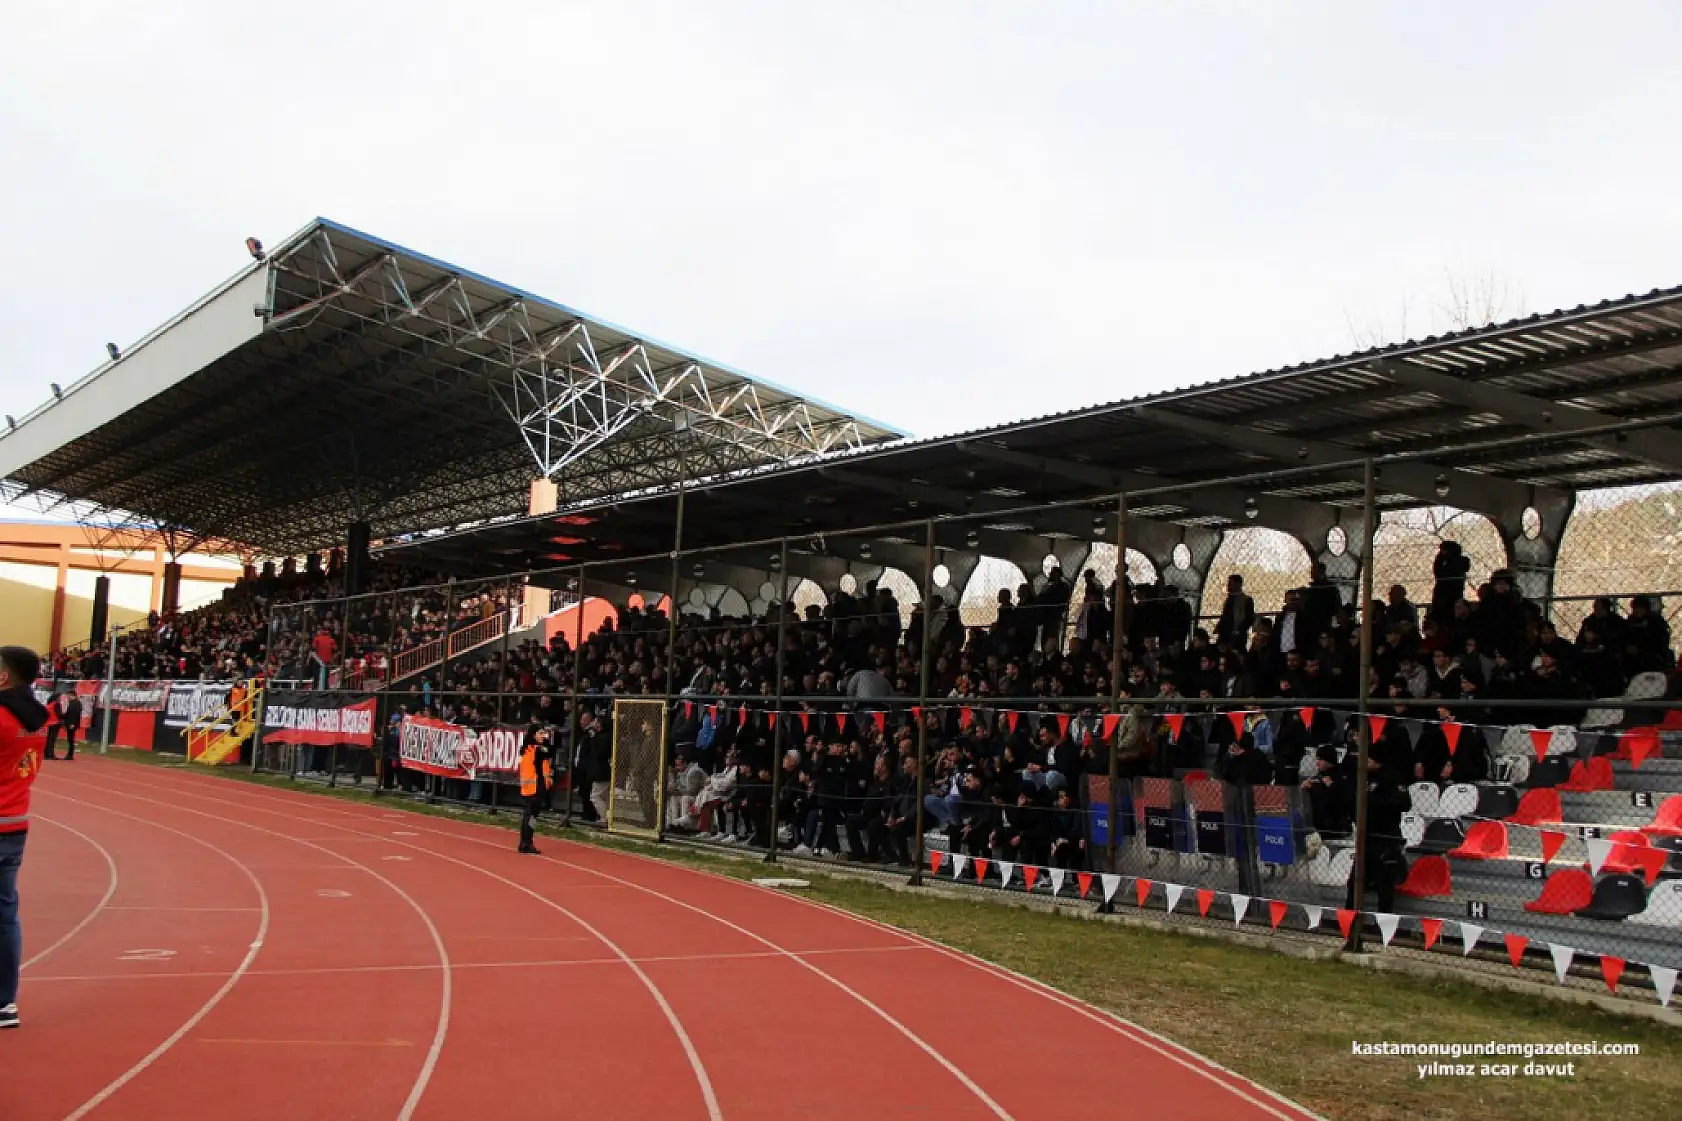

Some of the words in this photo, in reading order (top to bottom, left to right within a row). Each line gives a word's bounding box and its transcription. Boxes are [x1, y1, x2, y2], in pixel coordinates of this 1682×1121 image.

[1636, 793, 1647, 806] E
[1529, 865, 1542, 878] G
[1472, 902, 1484, 917] H
